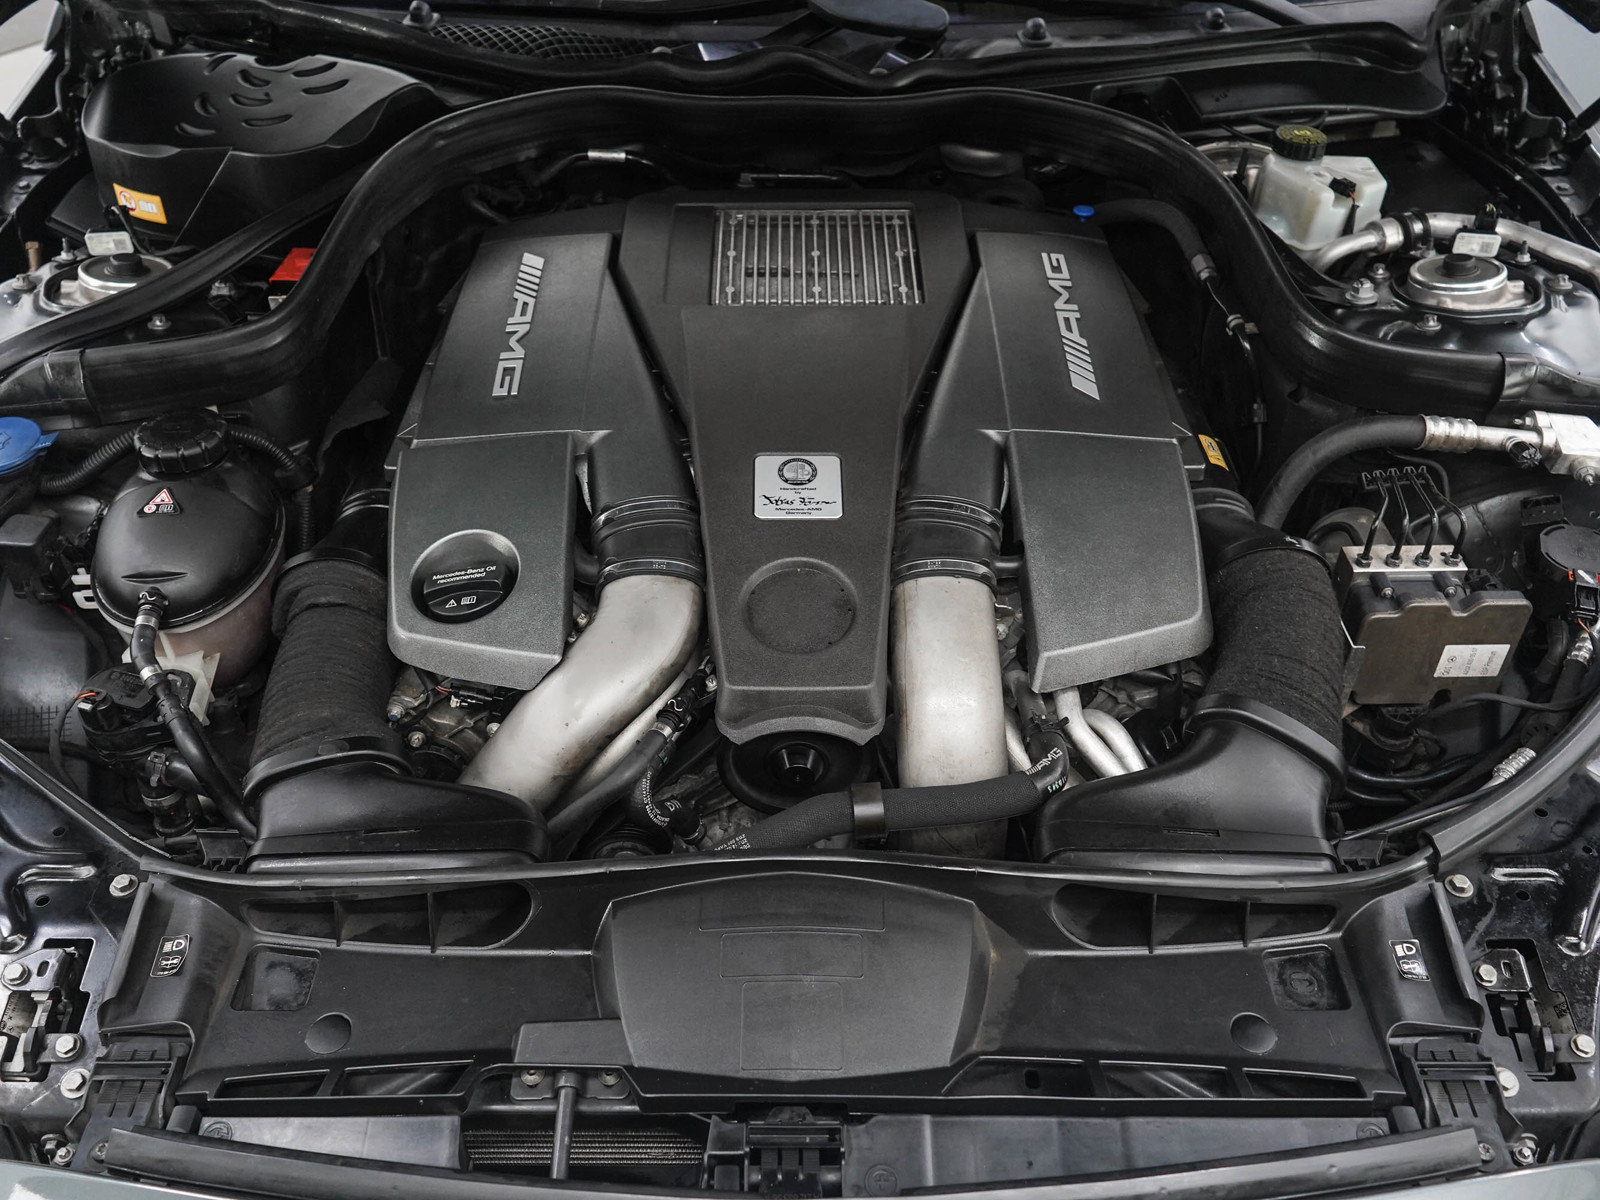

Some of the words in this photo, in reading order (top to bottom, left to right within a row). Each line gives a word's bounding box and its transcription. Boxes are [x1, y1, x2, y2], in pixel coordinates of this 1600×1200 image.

[1041, 252, 1089, 348] AMG
[492, 290, 537, 397] AMG
[432, 567, 485, 580] Mercedes-Benz
[437, 571, 486, 584] recommended
[1036, 747, 1063, 771] AMG
